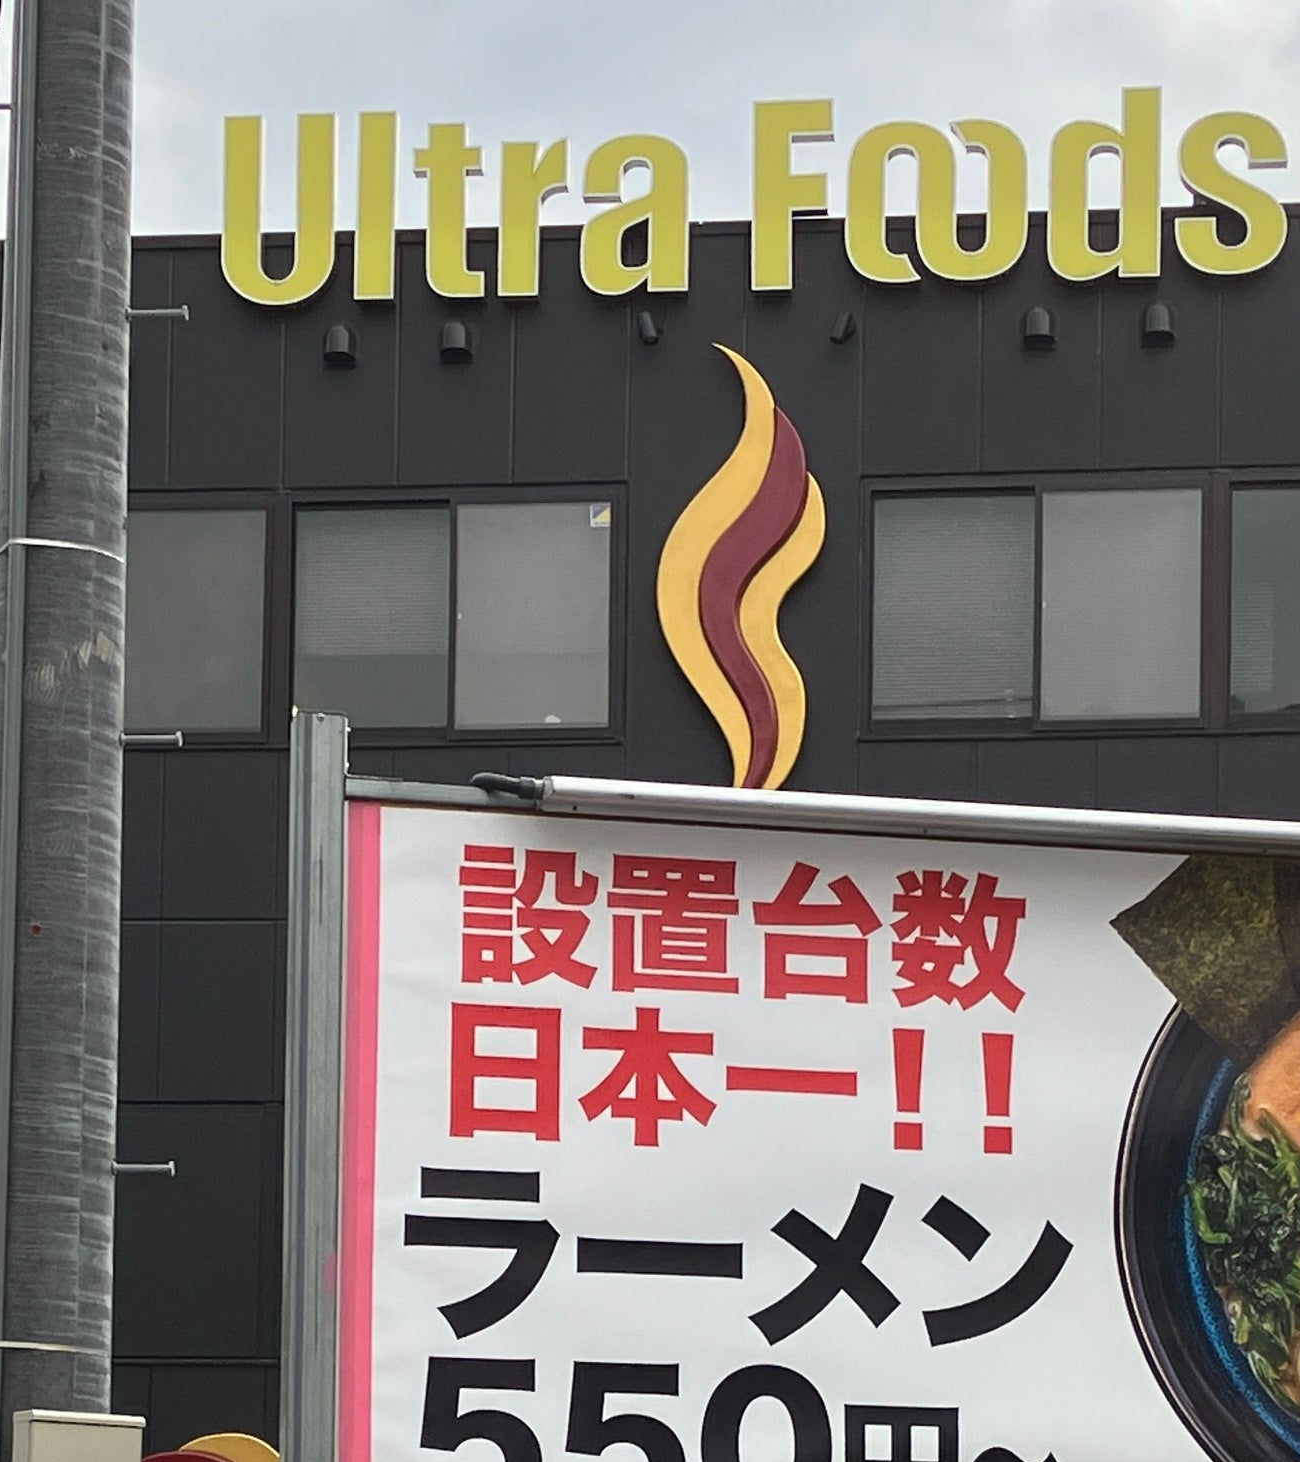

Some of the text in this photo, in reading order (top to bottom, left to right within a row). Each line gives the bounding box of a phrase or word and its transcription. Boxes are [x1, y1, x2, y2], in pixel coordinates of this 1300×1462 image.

[220, 85, 1288, 306] Ultra Foods
[458, 843, 1028, 1013] 設置台数
[402, 1165, 1075, 1348] ラーメン
